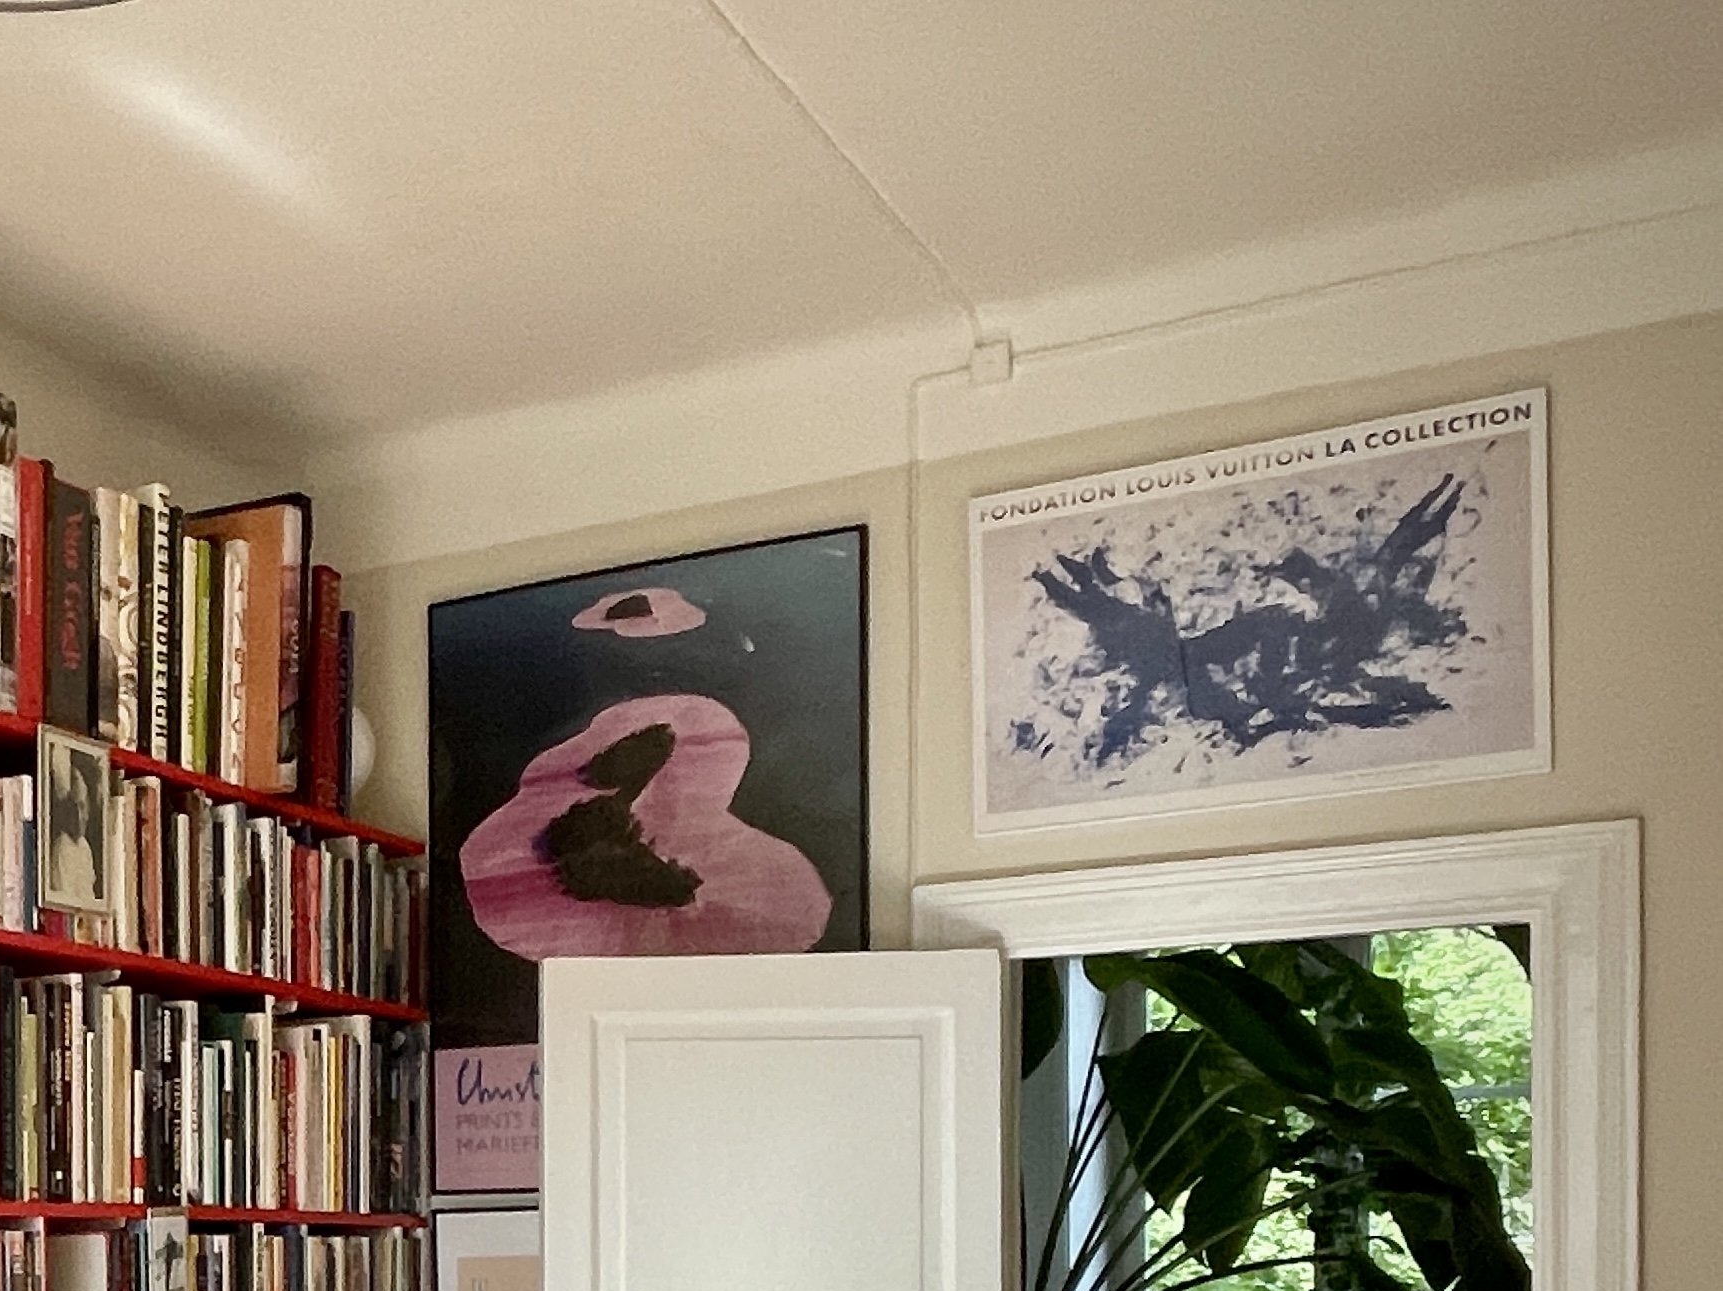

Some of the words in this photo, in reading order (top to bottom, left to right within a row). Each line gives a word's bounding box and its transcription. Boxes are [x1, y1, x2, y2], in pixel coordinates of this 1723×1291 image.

[979, 484, 1117, 523] FONDATION
[1125, 469, 1196, 496] LOUIS
[1204, 443, 1314, 480] VUITTON
[1324, 439, 1356, 458] LA
[1364, 403, 1533, 450] COLLECTION
[455, 1113, 526, 1132] PRINTS
